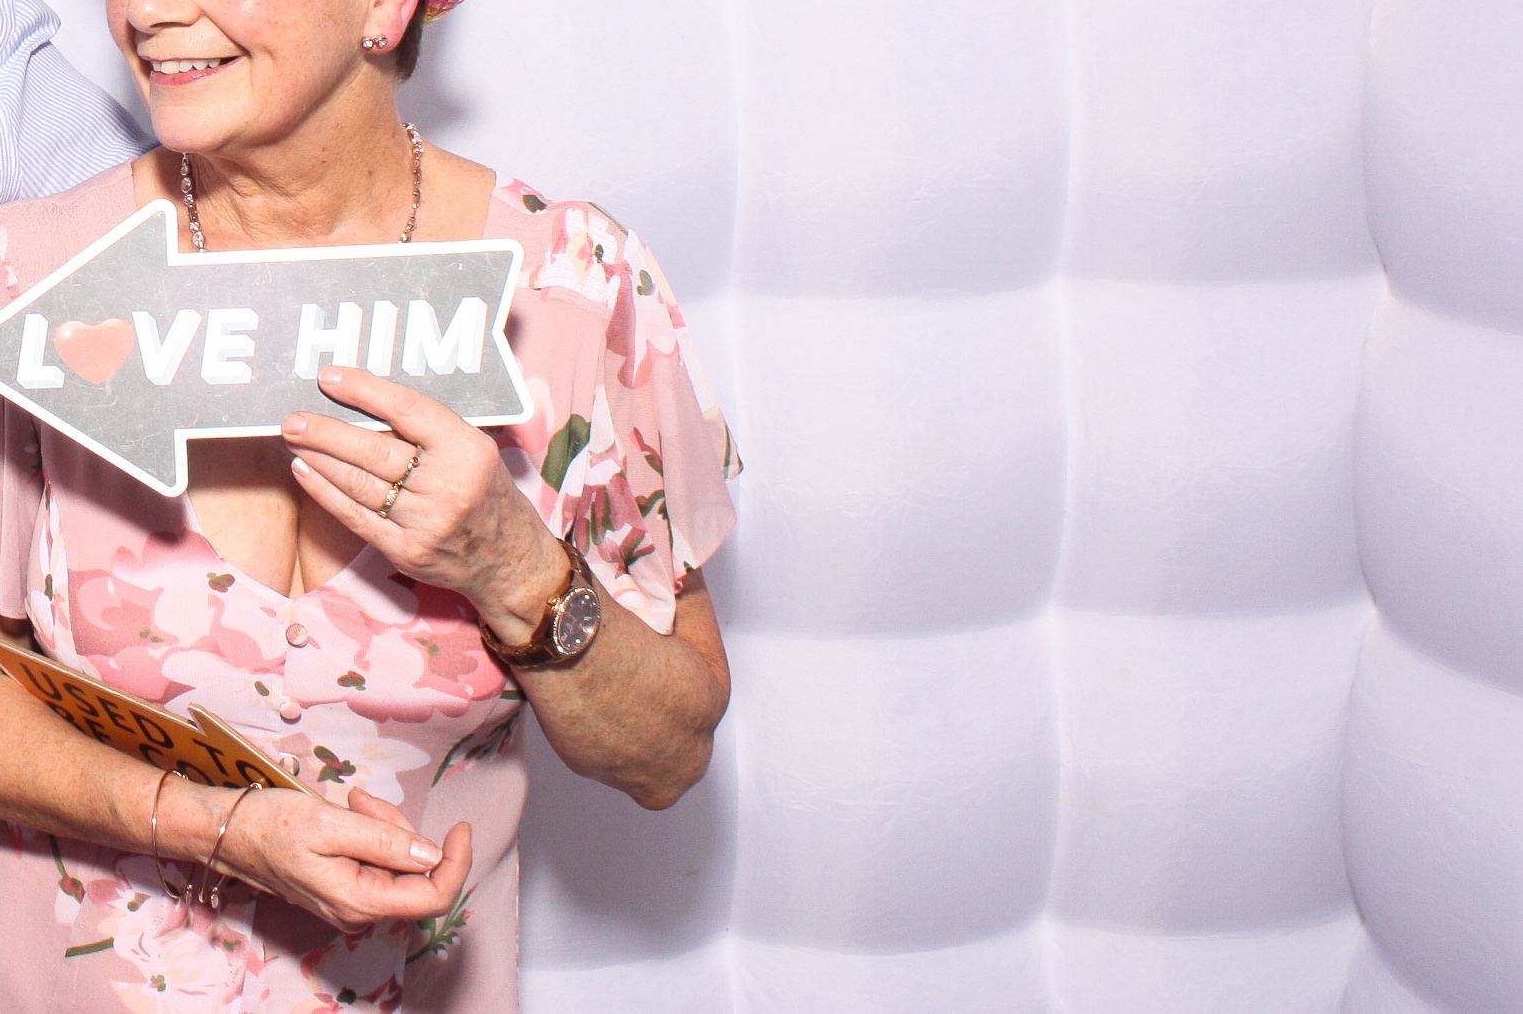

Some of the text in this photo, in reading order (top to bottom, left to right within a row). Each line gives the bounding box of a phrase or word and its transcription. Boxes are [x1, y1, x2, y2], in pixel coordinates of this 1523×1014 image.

[292, 296, 488, 380] HIM
[20, 662, 276, 789] USED TO
